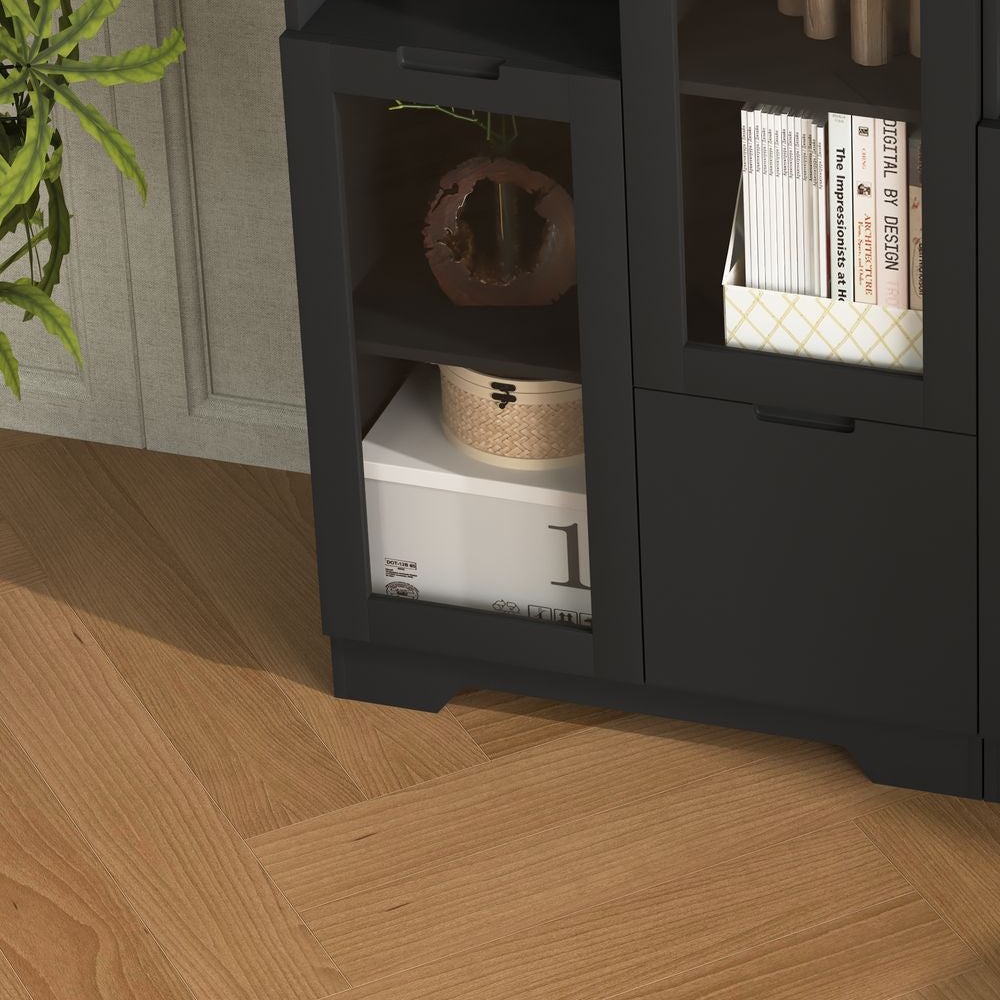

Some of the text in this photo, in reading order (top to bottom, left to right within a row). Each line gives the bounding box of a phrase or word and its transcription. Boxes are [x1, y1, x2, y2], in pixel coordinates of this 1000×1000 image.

[836, 147, 846, 171] The
[883, 120, 898, 178] DIGITAL
[834, 175, 847, 268] Impressionists
[884, 188, 898, 207] BY
[864, 213, 873, 296] ARCHITECTURE
[884, 215, 899, 271] DESIGN
[837, 272, 847, 286] at
